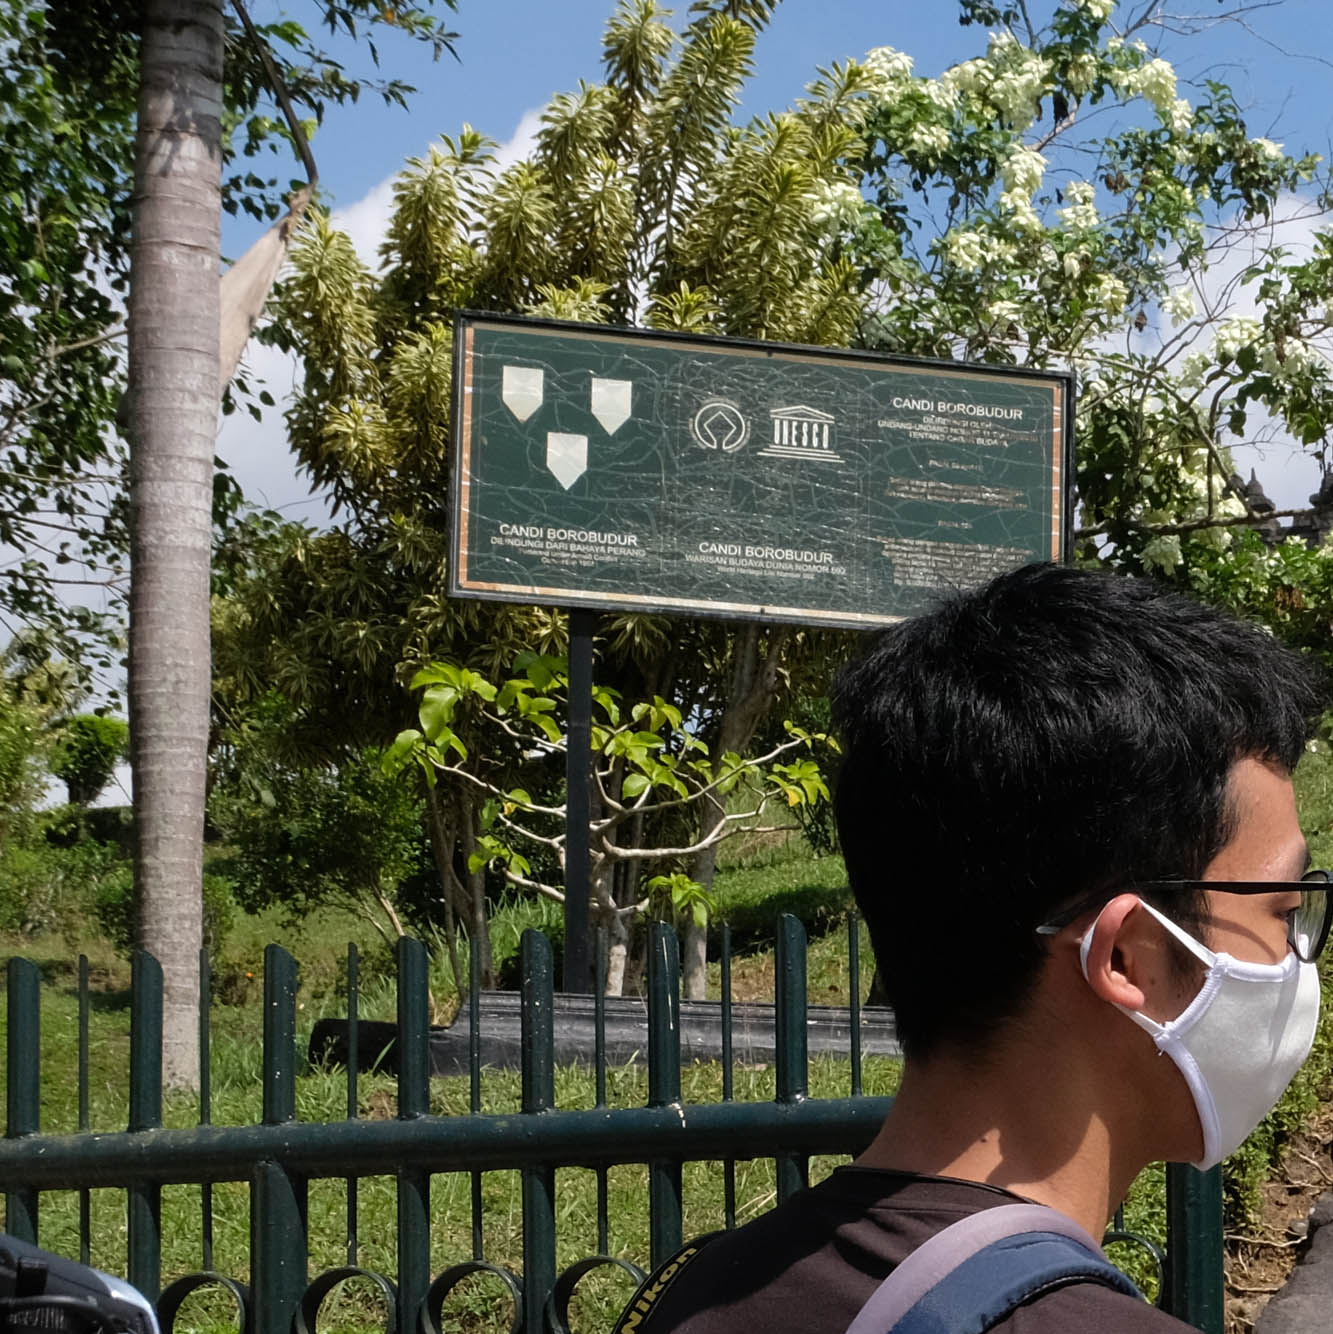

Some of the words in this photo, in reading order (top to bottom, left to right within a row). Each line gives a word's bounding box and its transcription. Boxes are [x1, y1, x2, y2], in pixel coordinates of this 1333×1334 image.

[892, 397, 934, 412] CANDI
[937, 401, 1023, 420] BOROBUDUR
[774, 418, 829, 449] UNESCO
[499, 523, 543, 538] CANDI
[547, 528, 638, 546] BOROBUDUR
[685, 553, 727, 564] WARISAN
[728, 557, 765, 568] BUDAYA
[765, 561, 793, 571] DUNIA
[699, 542, 741, 556] CANDI
[745, 546, 833, 563] BOROBUDUR
